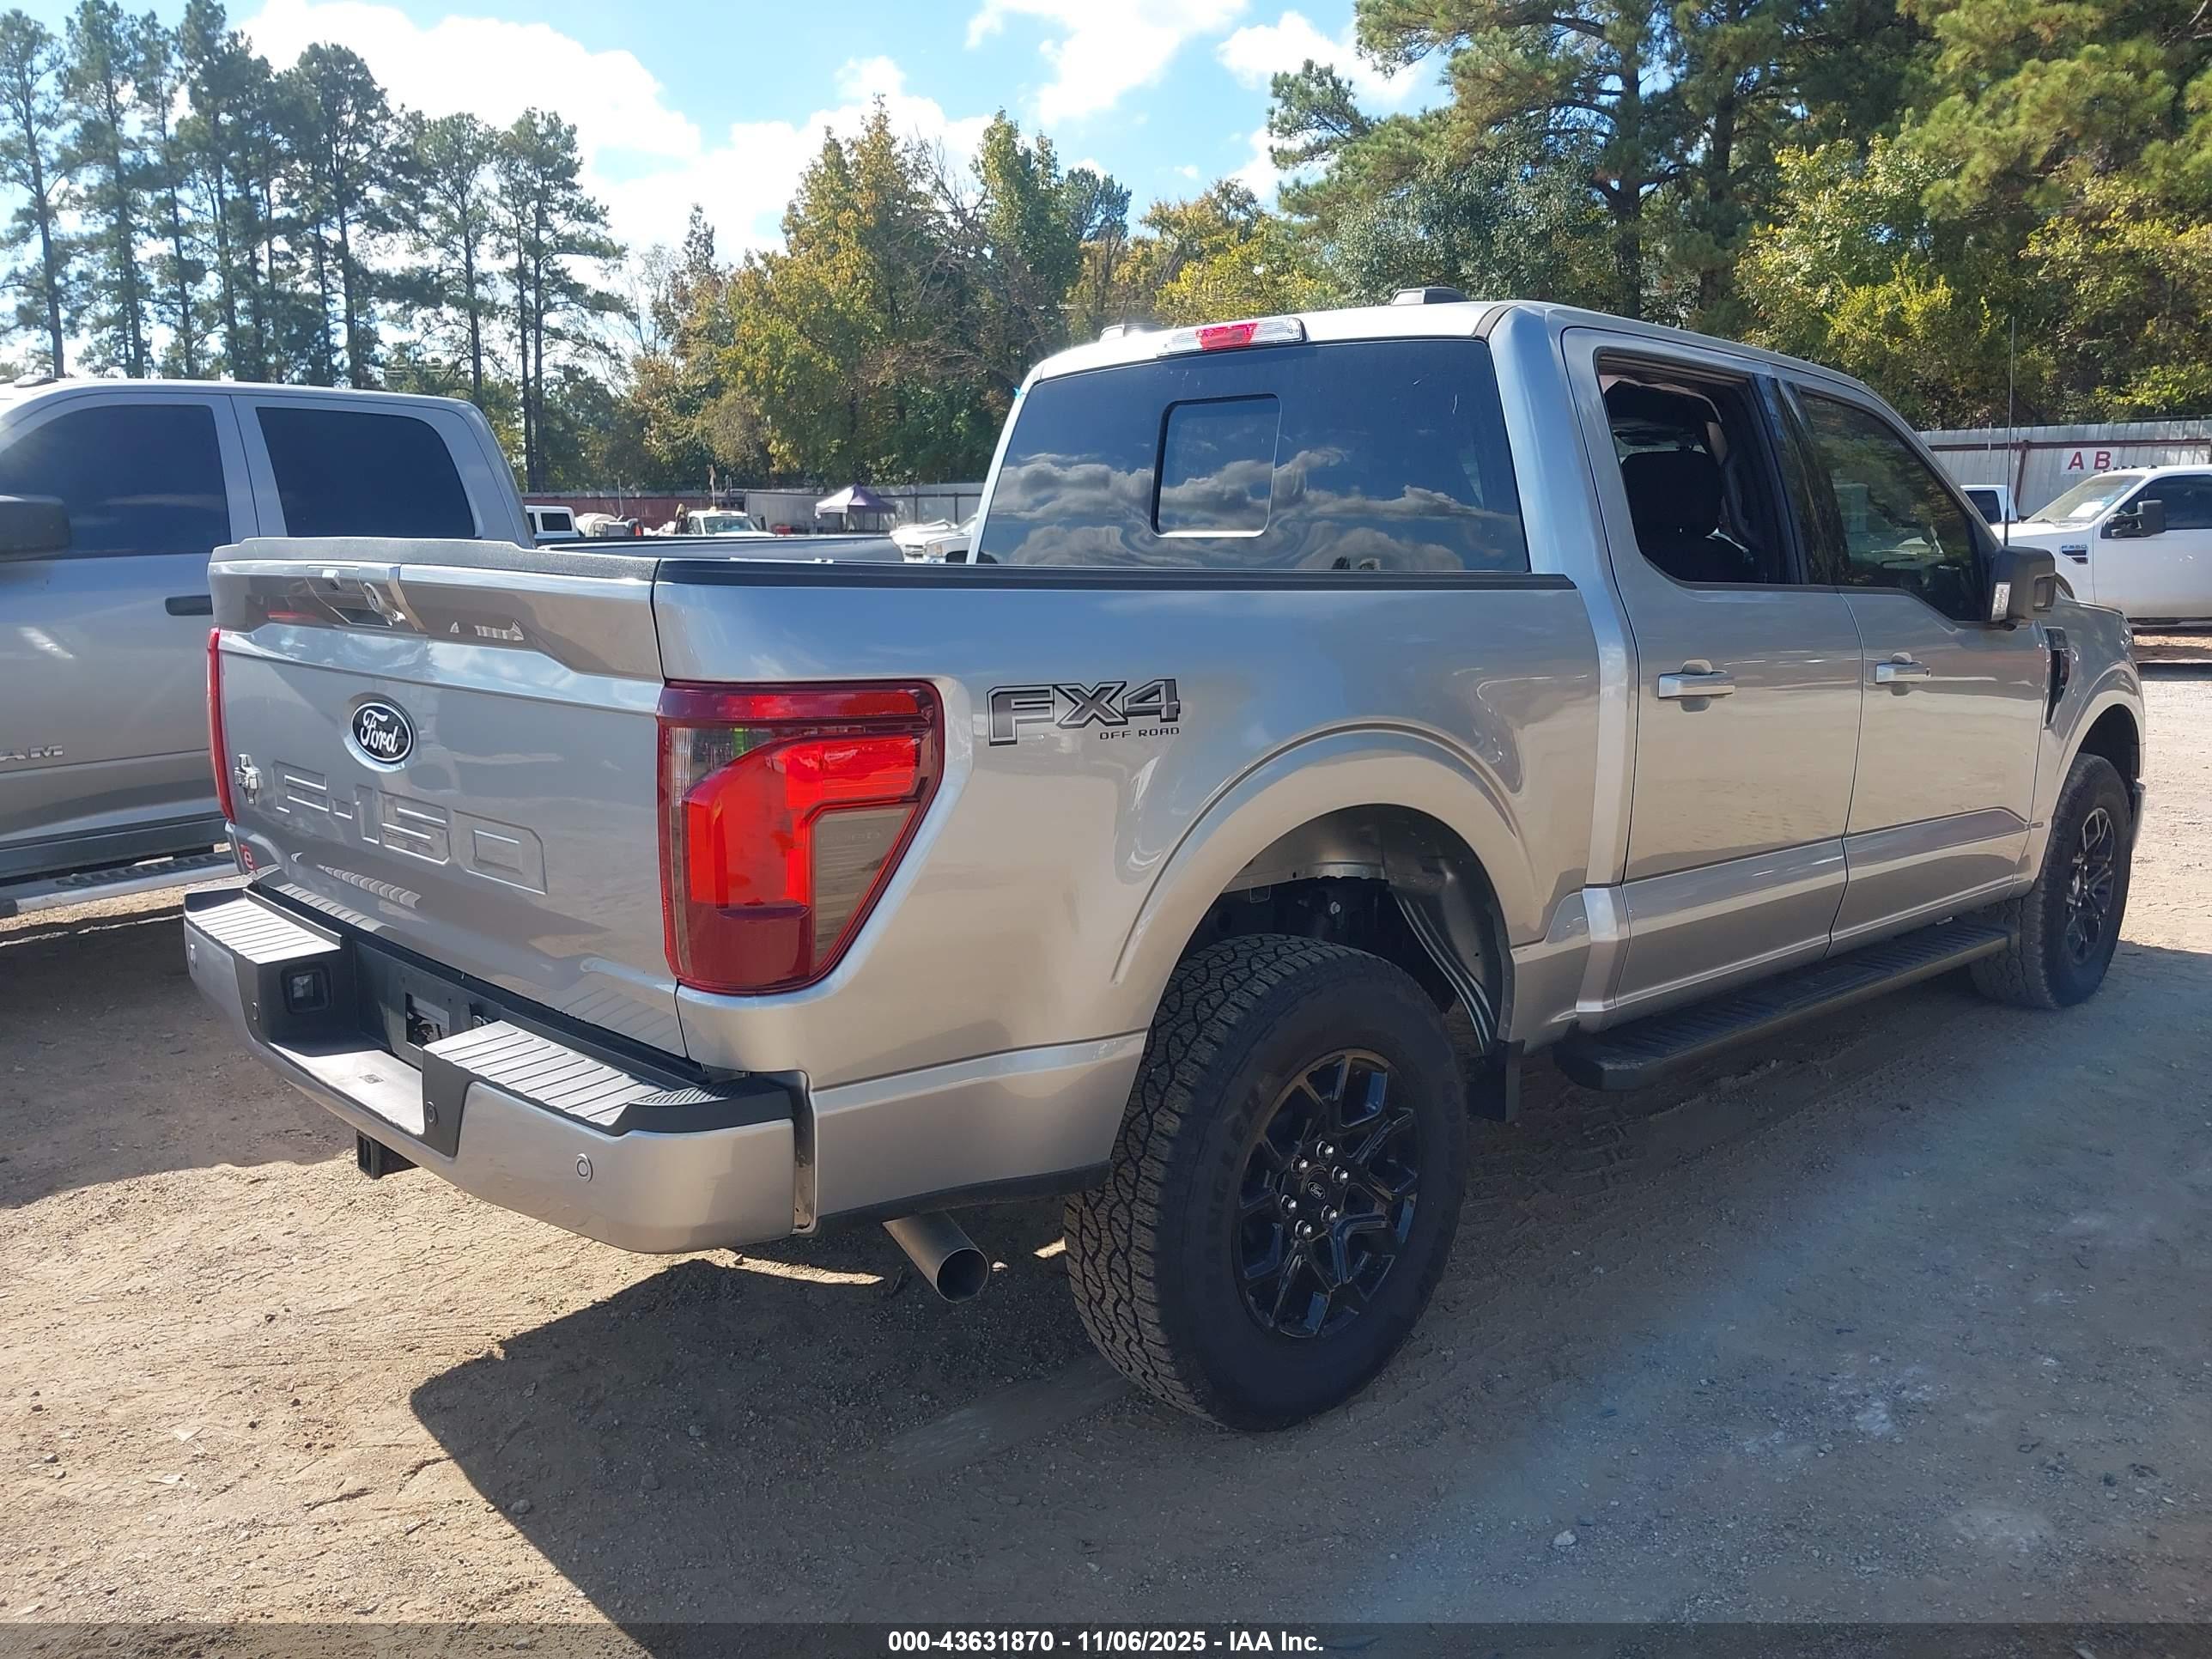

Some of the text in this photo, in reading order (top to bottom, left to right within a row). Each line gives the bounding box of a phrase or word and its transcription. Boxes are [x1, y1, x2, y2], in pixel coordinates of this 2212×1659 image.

[2068, 451, 2112, 470] A B
[360, 708, 399, 754] Ford
[986, 678, 1182, 747] FX4
[1099, 726, 1181, 741] OFF ROAD
[270, 759, 549, 895] F-150
